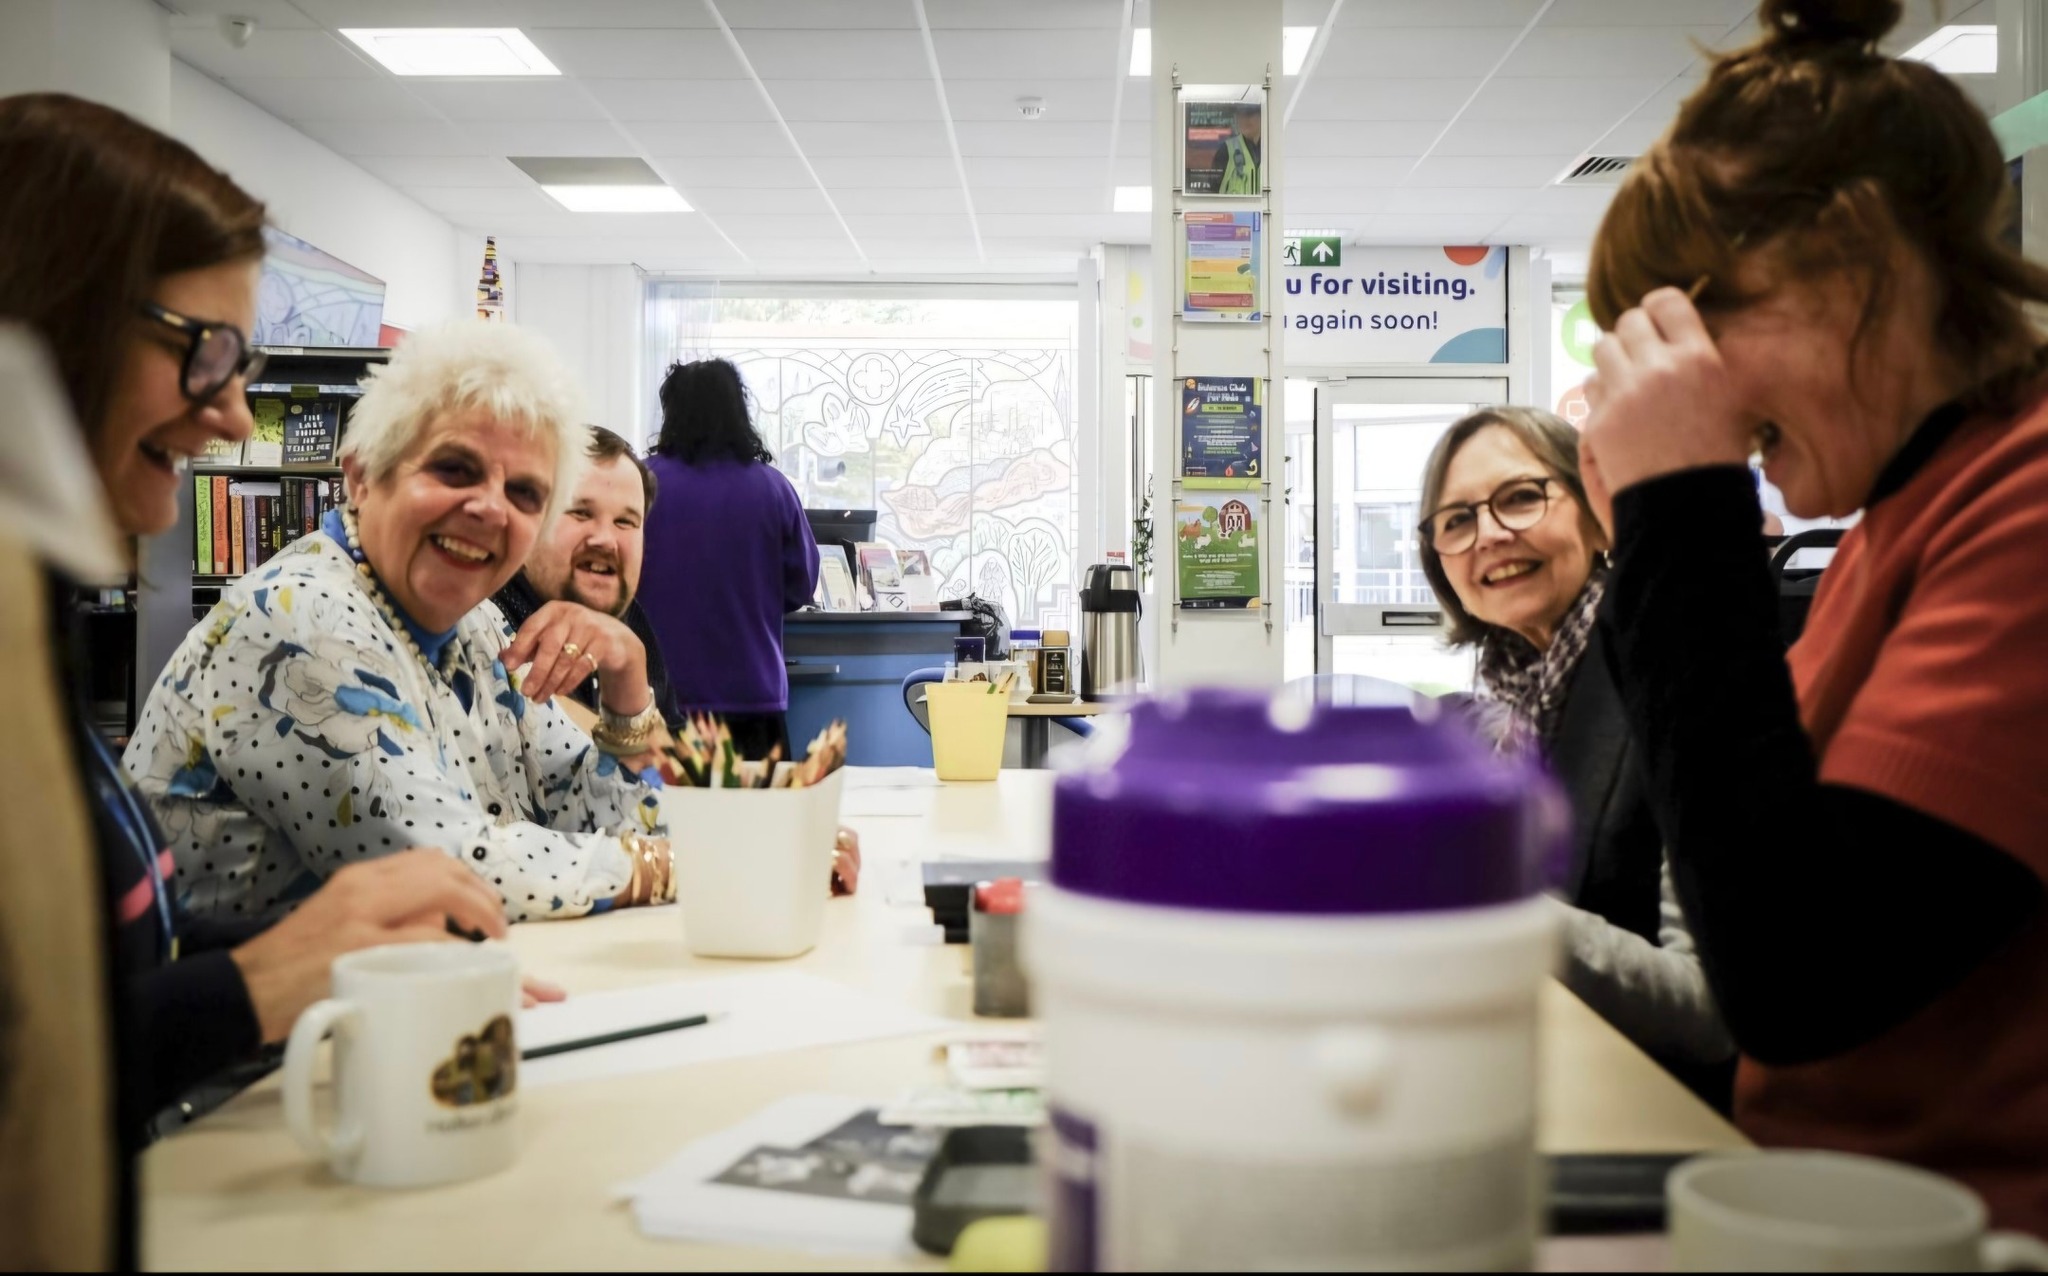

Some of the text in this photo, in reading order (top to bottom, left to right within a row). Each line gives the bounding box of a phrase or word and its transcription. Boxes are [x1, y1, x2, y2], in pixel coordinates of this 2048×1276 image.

[1310, 272, 1353, 295] for
[1361, 271, 1476, 301] visiting.
[1295, 309, 1362, 335] again
[1370, 310, 1438, 330] soon!
[298, 421, 324, 429] LAST
